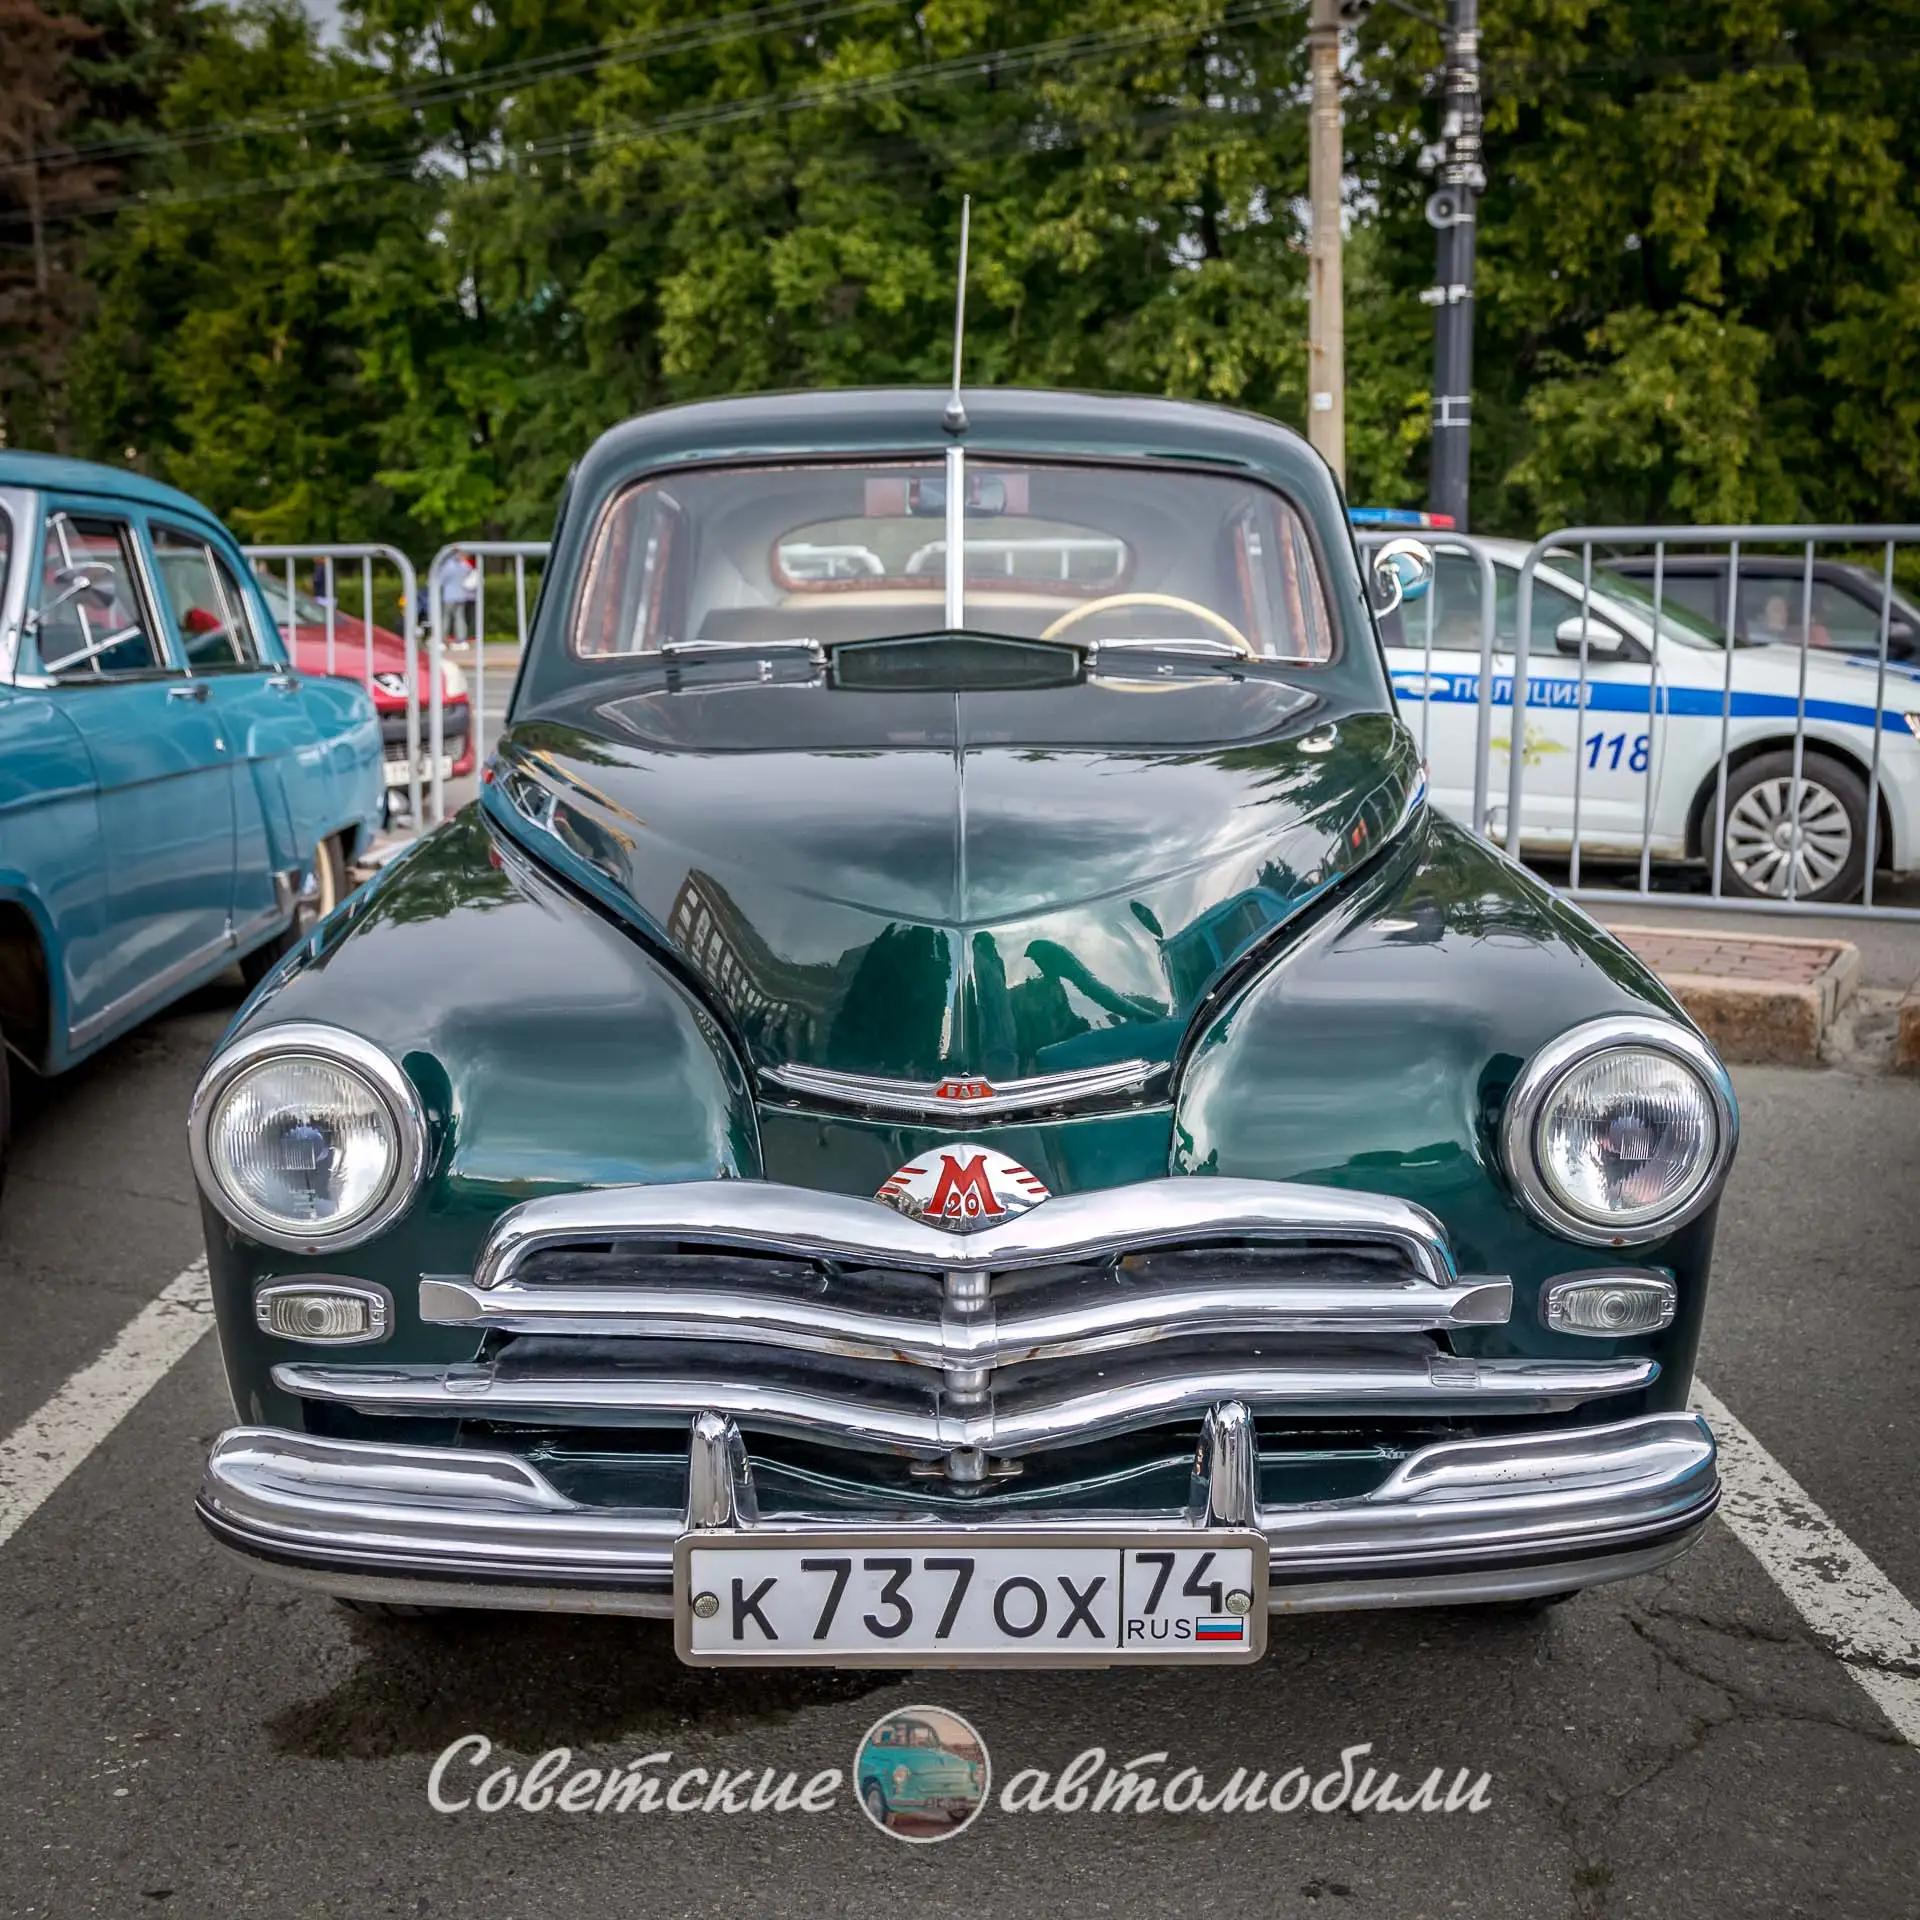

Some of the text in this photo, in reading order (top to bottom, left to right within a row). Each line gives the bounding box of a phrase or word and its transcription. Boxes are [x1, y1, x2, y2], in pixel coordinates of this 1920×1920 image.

[1453, 676, 1593, 707] ПЛЦИЯ
[1586, 731, 1651, 773] 118
[946, 1192, 979, 1217] 20
[1135, 1551, 1223, 1615] 74
[1127, 1618, 1192, 1640] RUS
